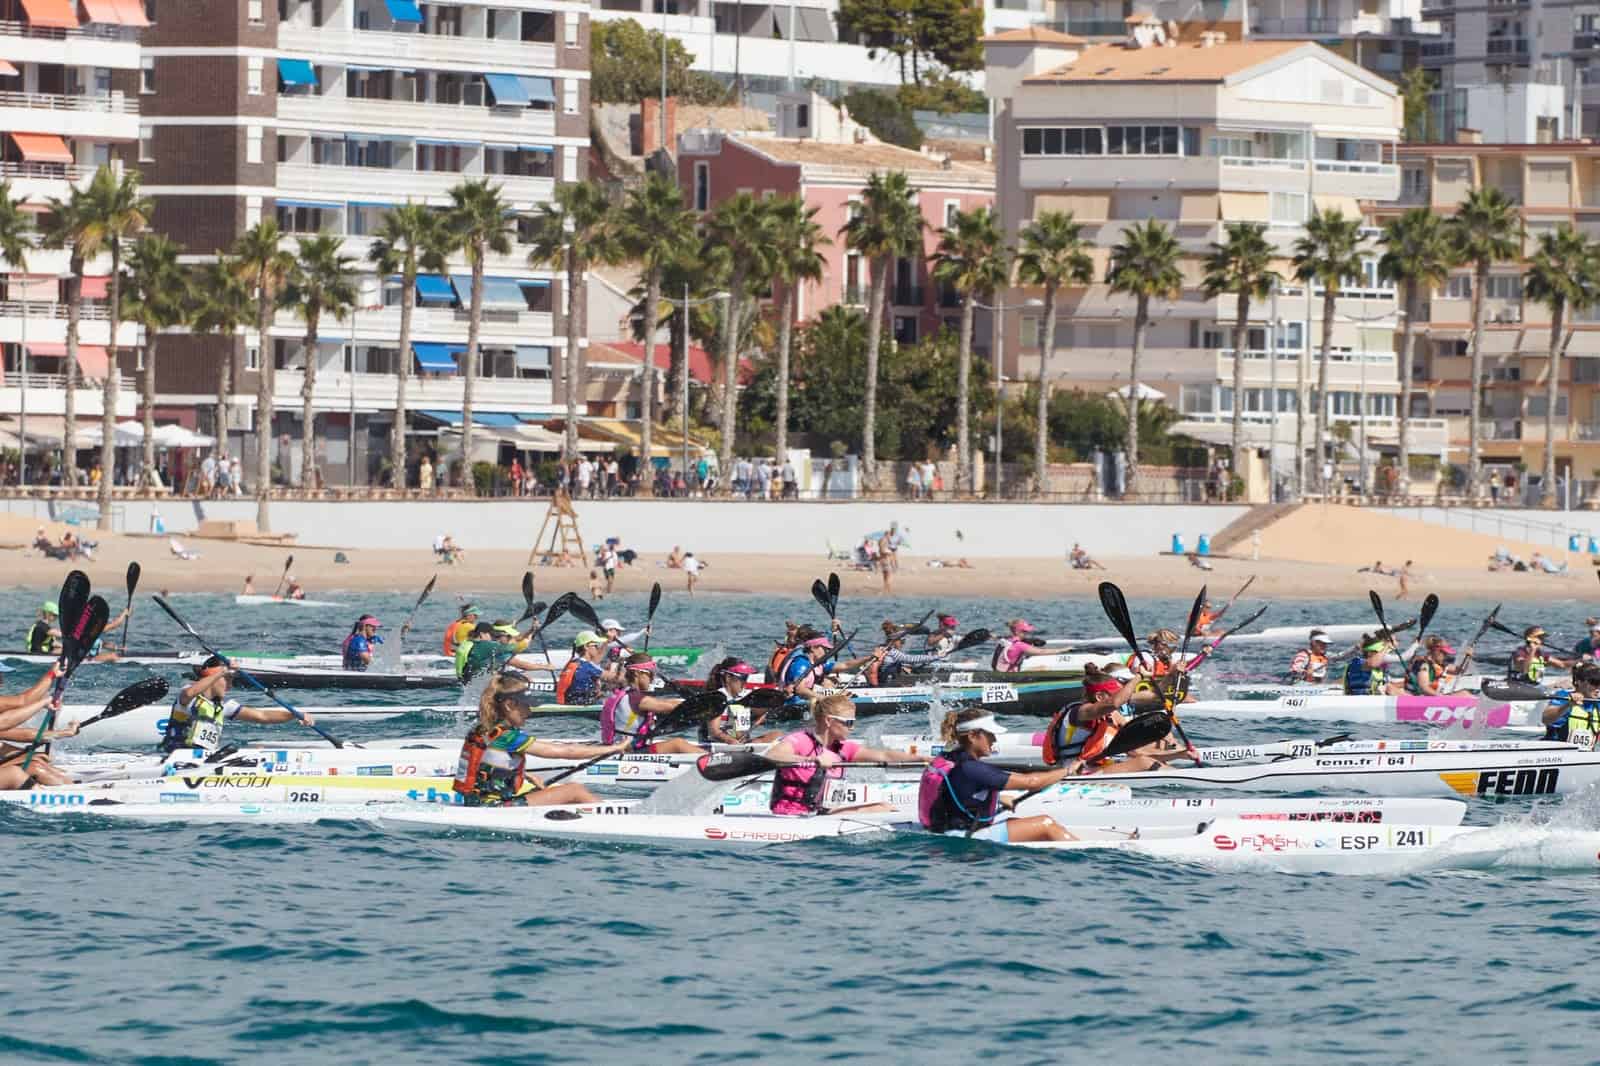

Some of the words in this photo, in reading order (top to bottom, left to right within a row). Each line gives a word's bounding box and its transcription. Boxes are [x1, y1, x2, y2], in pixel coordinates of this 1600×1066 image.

[986, 690, 1014, 702] FRA
[200, 729, 217, 742] 345
[1202, 751, 1259, 761] MENGUAL
[1291, 745, 1312, 757] 275
[1340, 835, 1379, 850] ESP
[1396, 830, 1424, 846] 241
